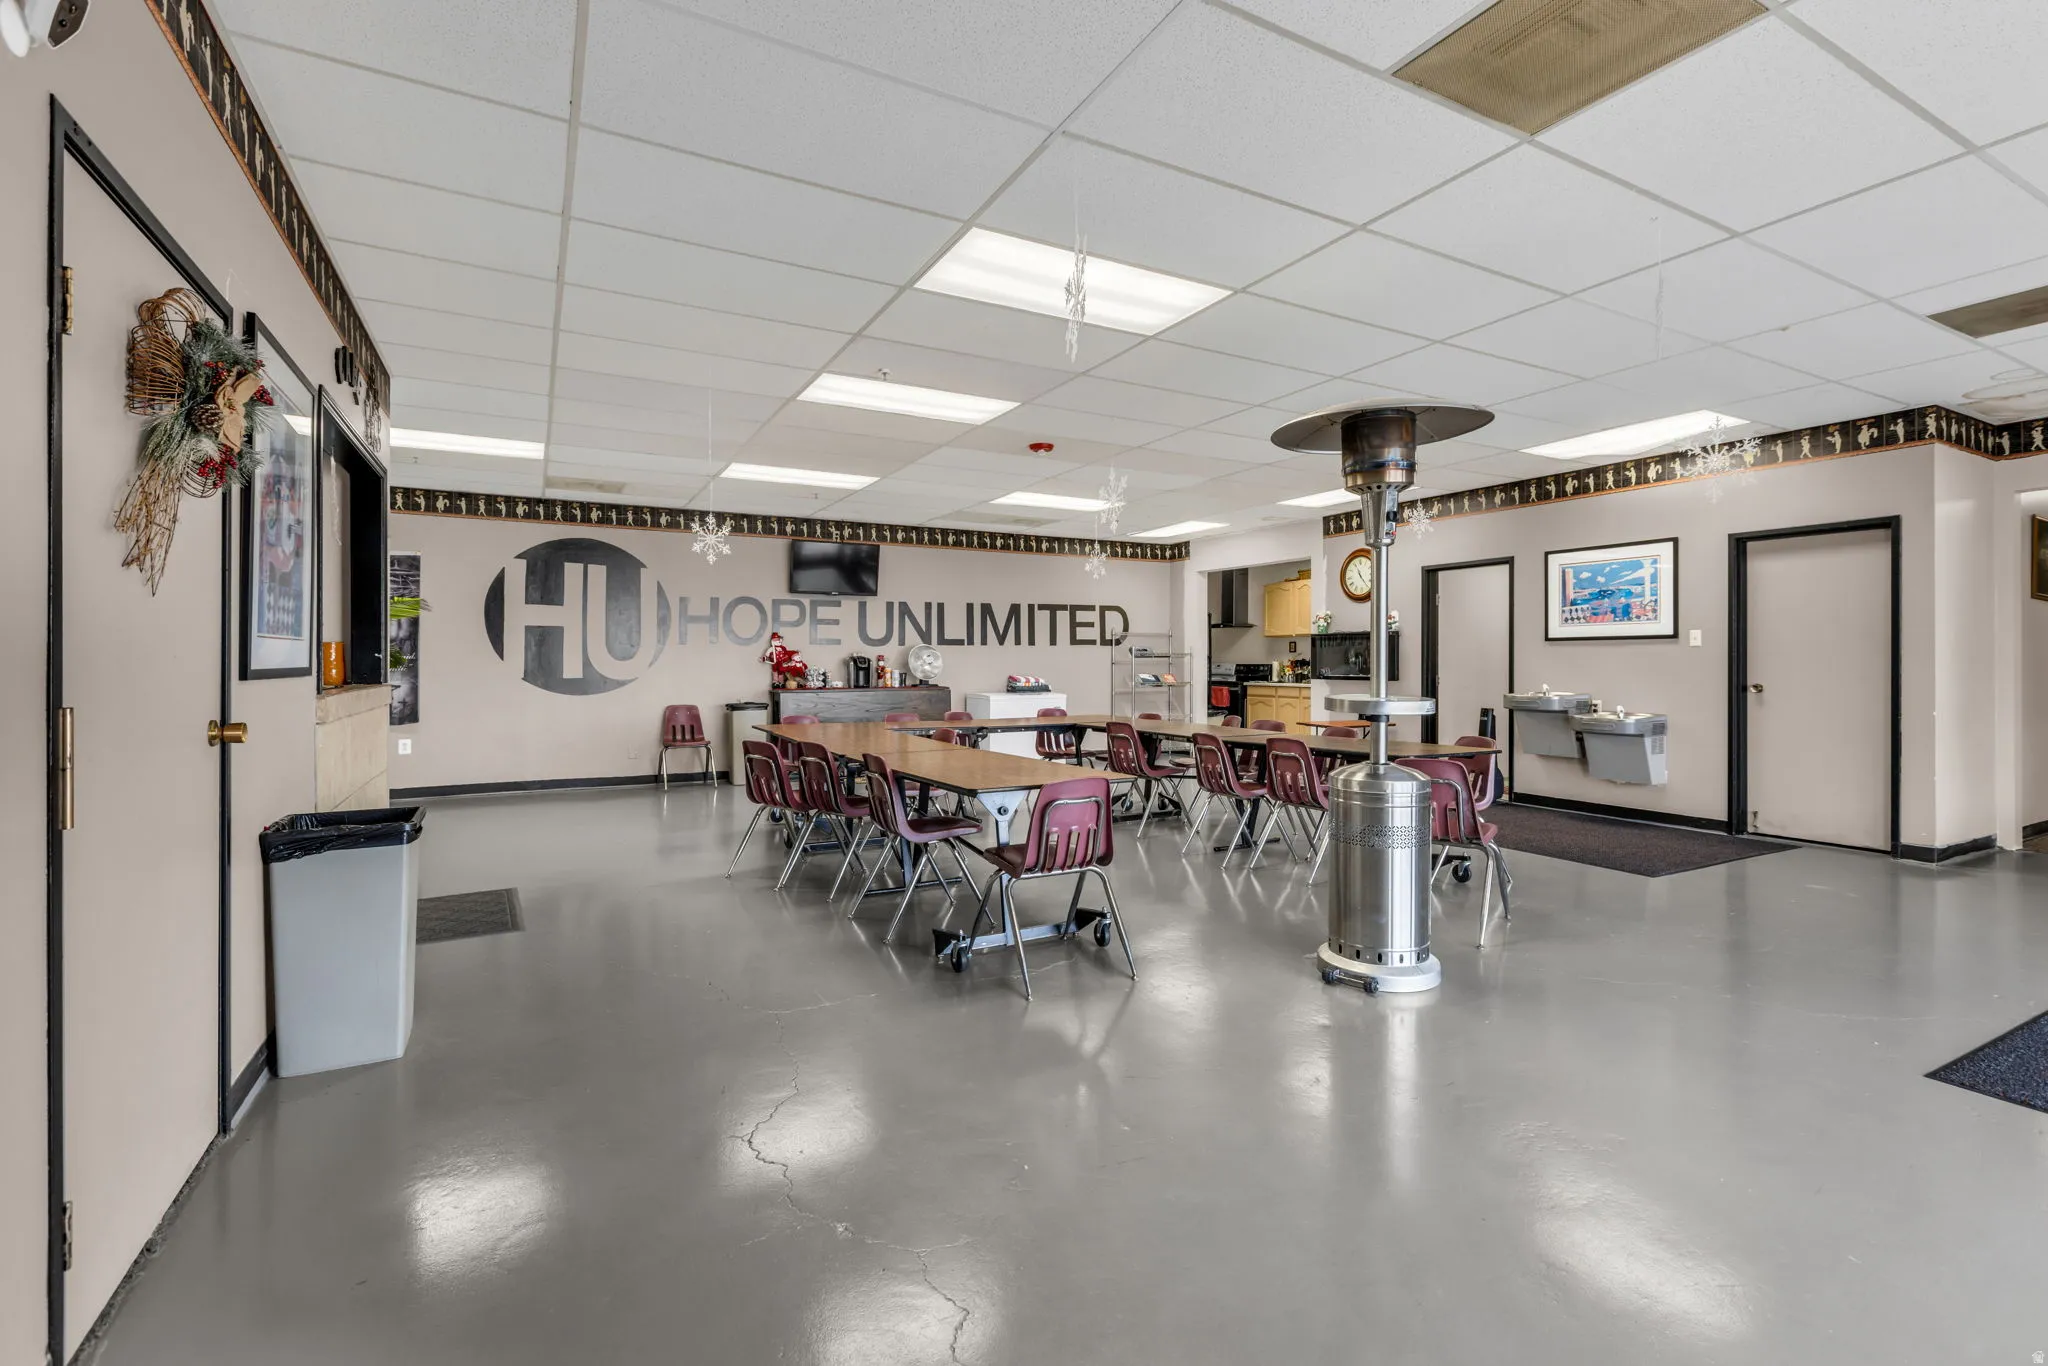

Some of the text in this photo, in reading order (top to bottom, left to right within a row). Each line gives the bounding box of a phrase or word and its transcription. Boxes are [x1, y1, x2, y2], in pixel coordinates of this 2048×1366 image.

[503, 557, 659, 681] HU
[678, 596, 1130, 647] HOPE UNLIMITED
